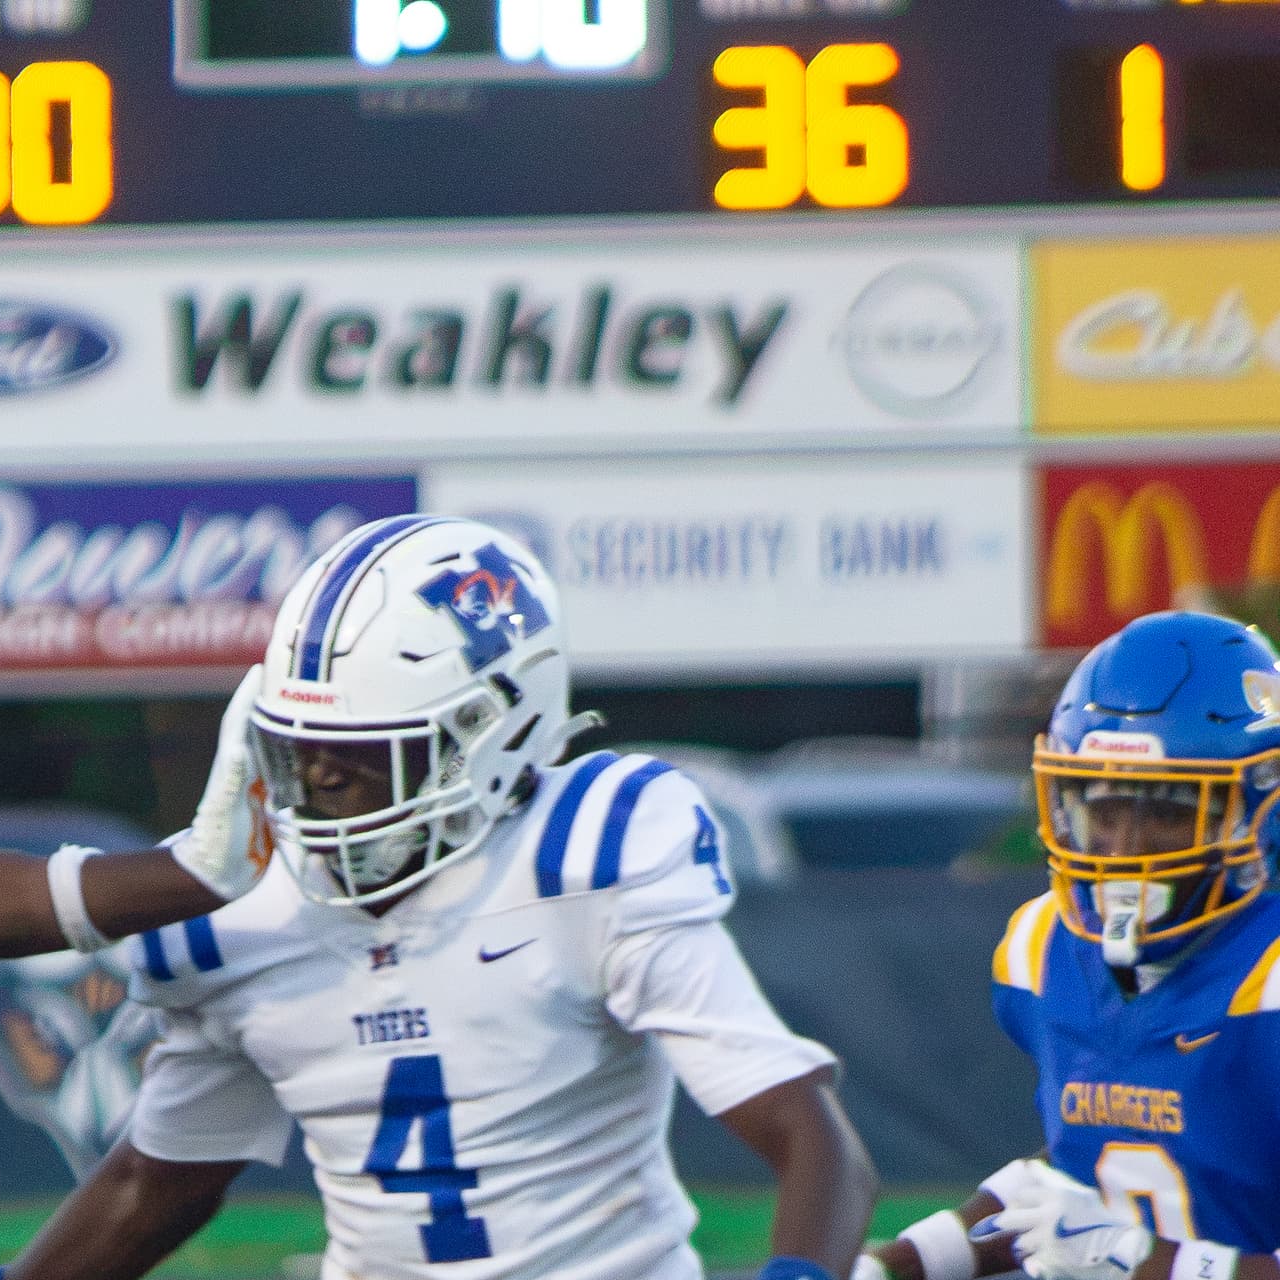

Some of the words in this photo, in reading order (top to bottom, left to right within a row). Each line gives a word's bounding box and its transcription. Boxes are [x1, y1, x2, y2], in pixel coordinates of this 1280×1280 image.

[713, 42, 909, 210] 36
[1120, 43, 1165, 191] 1
[165, 285, 790, 410] Weakley
[565, 515, 785, 582] SECURITY
[820, 508, 948, 578] BANK
[693, 804, 732, 895] 4
[351, 1006, 431, 1046] TIGERS
[1060, 1081, 1185, 1134] CHARGERS
[363, 1053, 493, 1263] 4
